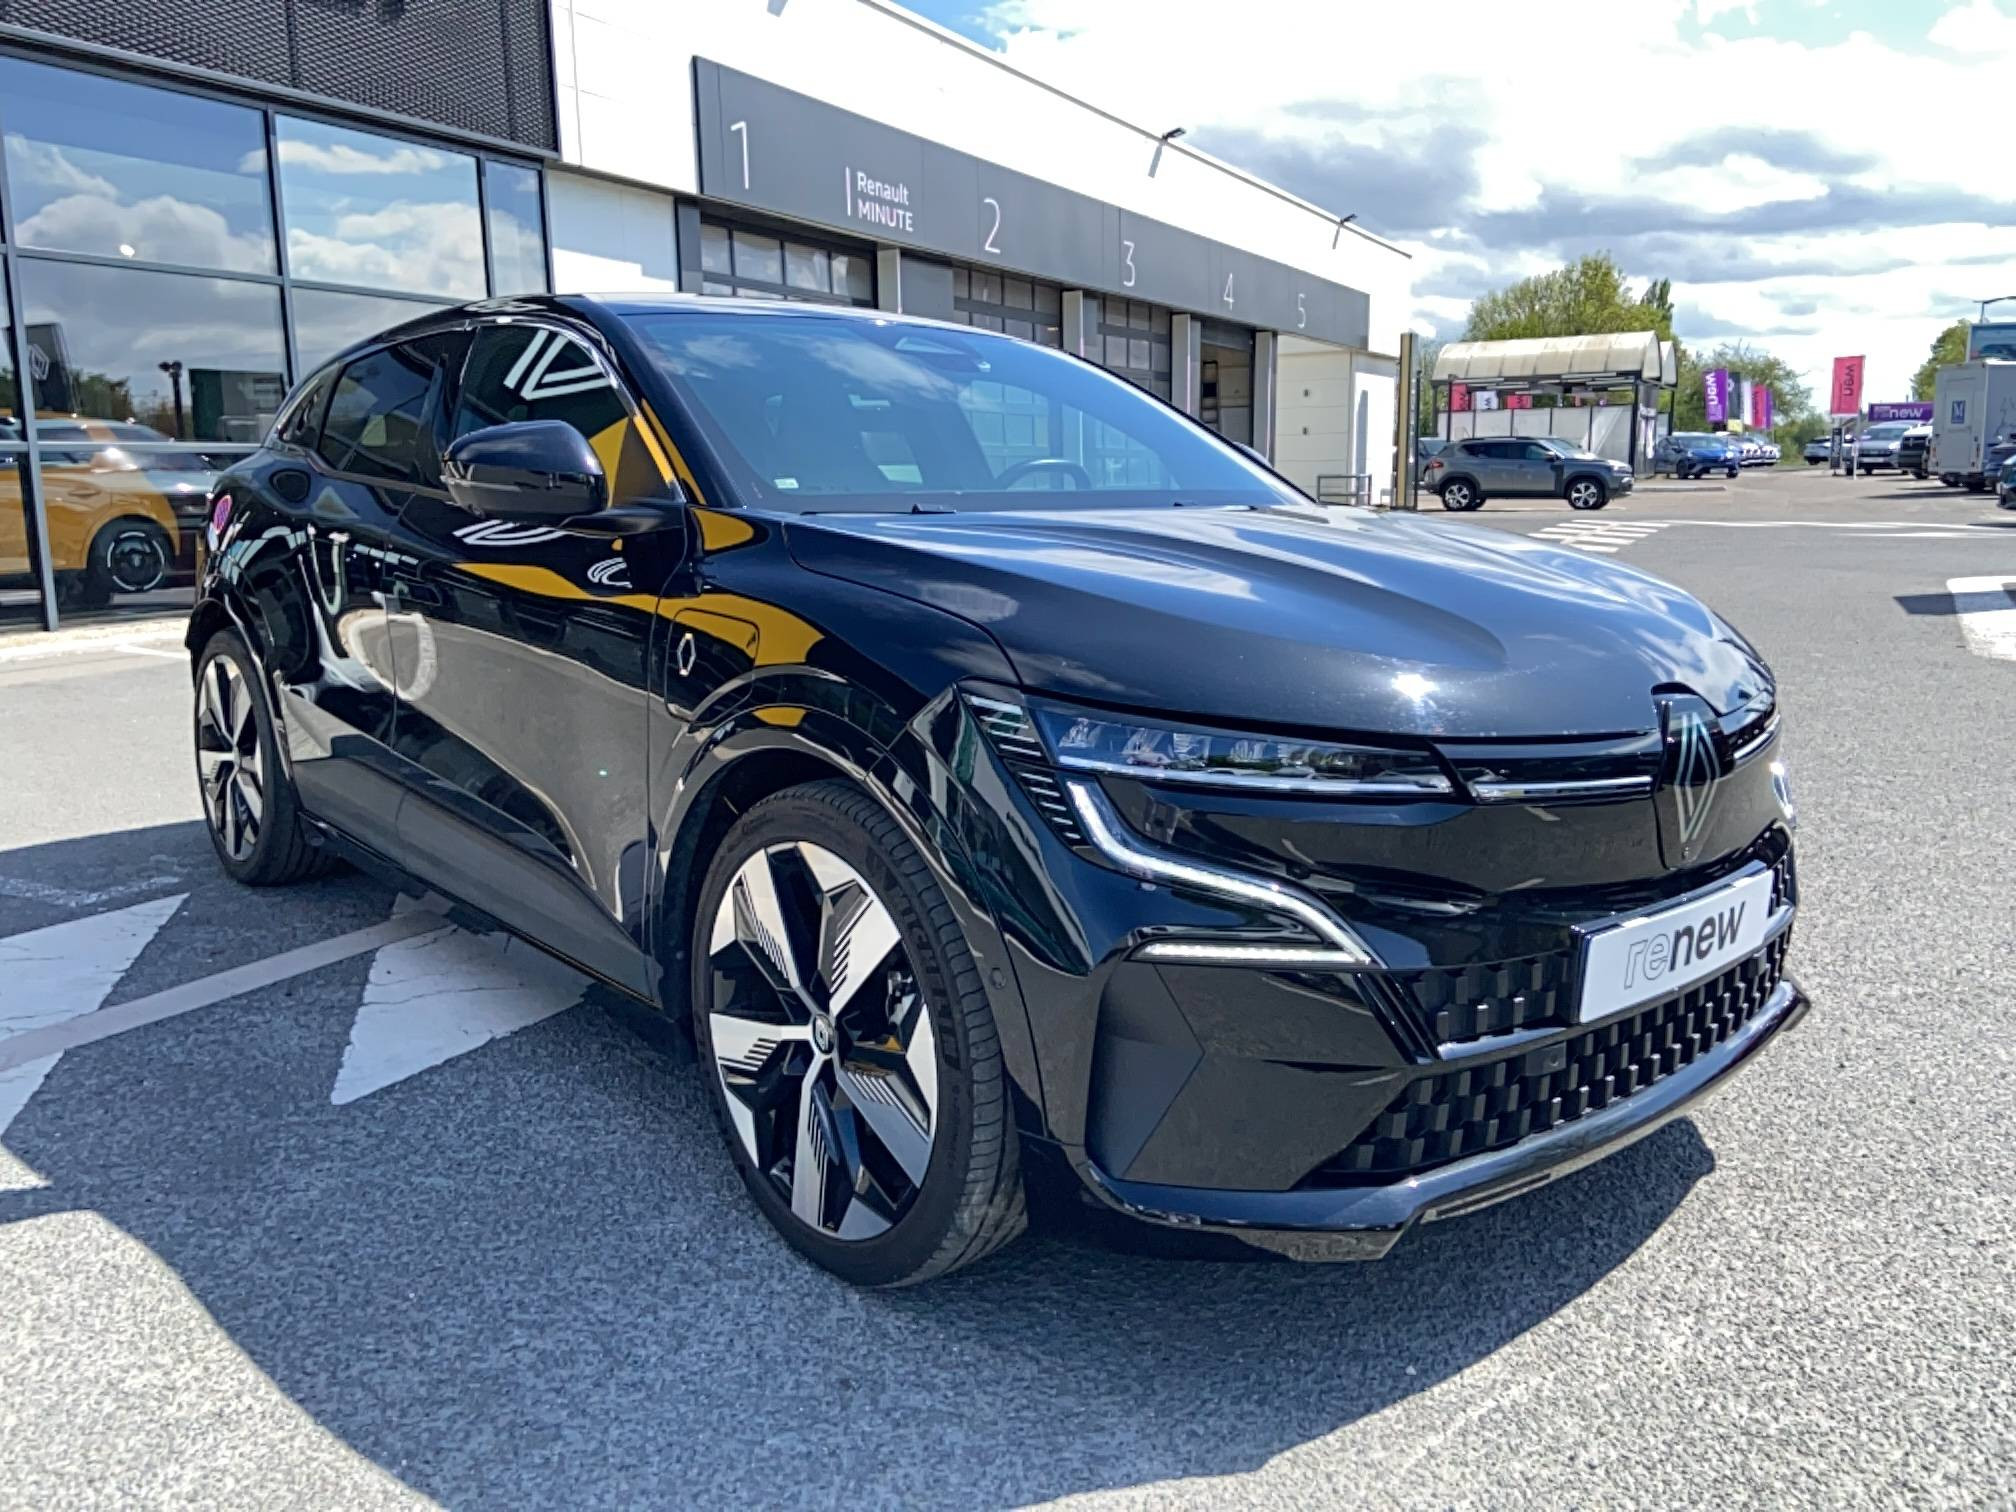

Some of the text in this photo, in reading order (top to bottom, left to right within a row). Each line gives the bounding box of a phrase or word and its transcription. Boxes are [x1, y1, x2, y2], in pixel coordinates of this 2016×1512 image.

[730, 120, 750, 190] 1
[856, 171, 910, 206] Renault
[856, 201, 914, 232] MINUTE
[982, 198, 1001, 254] 2
[1121, 240, 1136, 287] 3
[1223, 273, 1236, 311] 4
[1296, 293, 1307, 329] 5
[1623, 900, 1747, 991] renew
